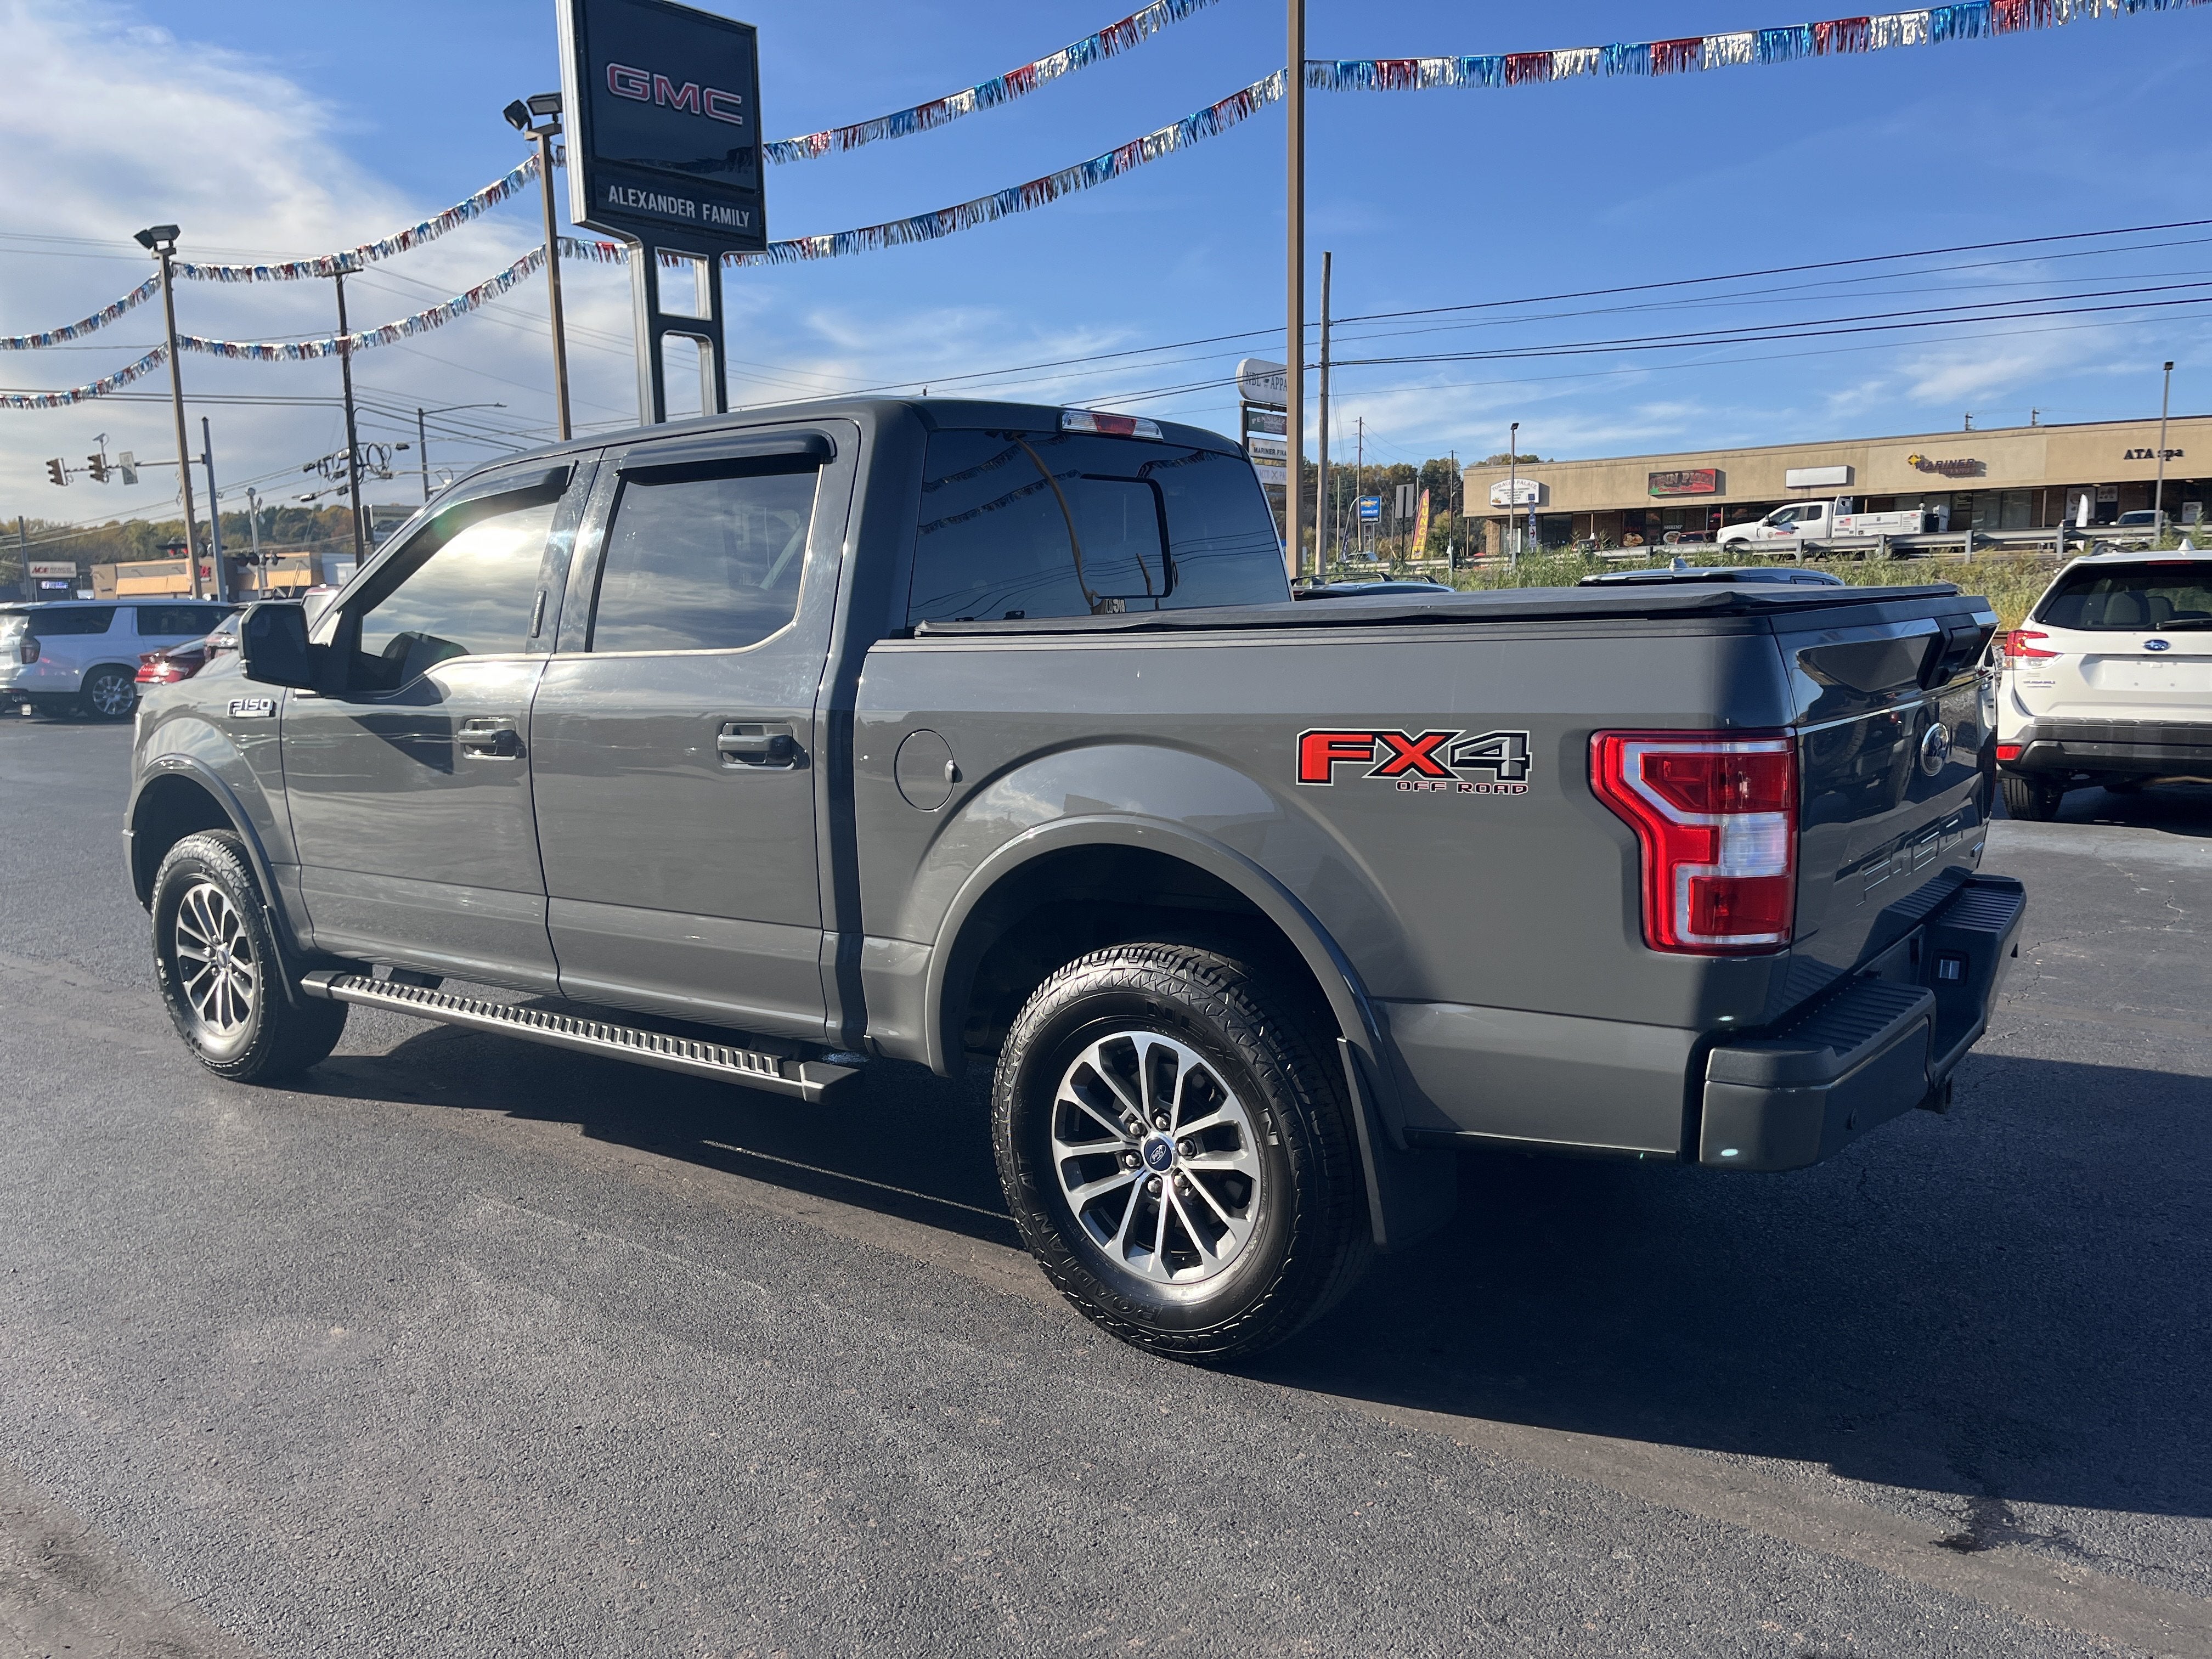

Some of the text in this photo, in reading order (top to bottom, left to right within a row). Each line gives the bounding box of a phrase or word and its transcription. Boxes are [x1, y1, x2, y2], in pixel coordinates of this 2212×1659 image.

[606, 63, 743, 126] GMC
[608, 185, 750, 228] ALEXANDER FAMILY
[1251, 416, 1271, 425] PENN
[1254, 447, 1276, 455] MARINER
[1916, 458, 1976, 470] MARINER
[2123, 448, 2185, 461] ATA spa
[1516, 480, 1537, 490] PALACE
[1415, 497, 1429, 545] LUNCH
[1296, 727, 1533, 786] FX4
[1396, 780, 1529, 795] OFF ROAD
[1146, 997, 1280, 1147] NEXEN
[1032, 1211, 1165, 1325] ROADIAN
